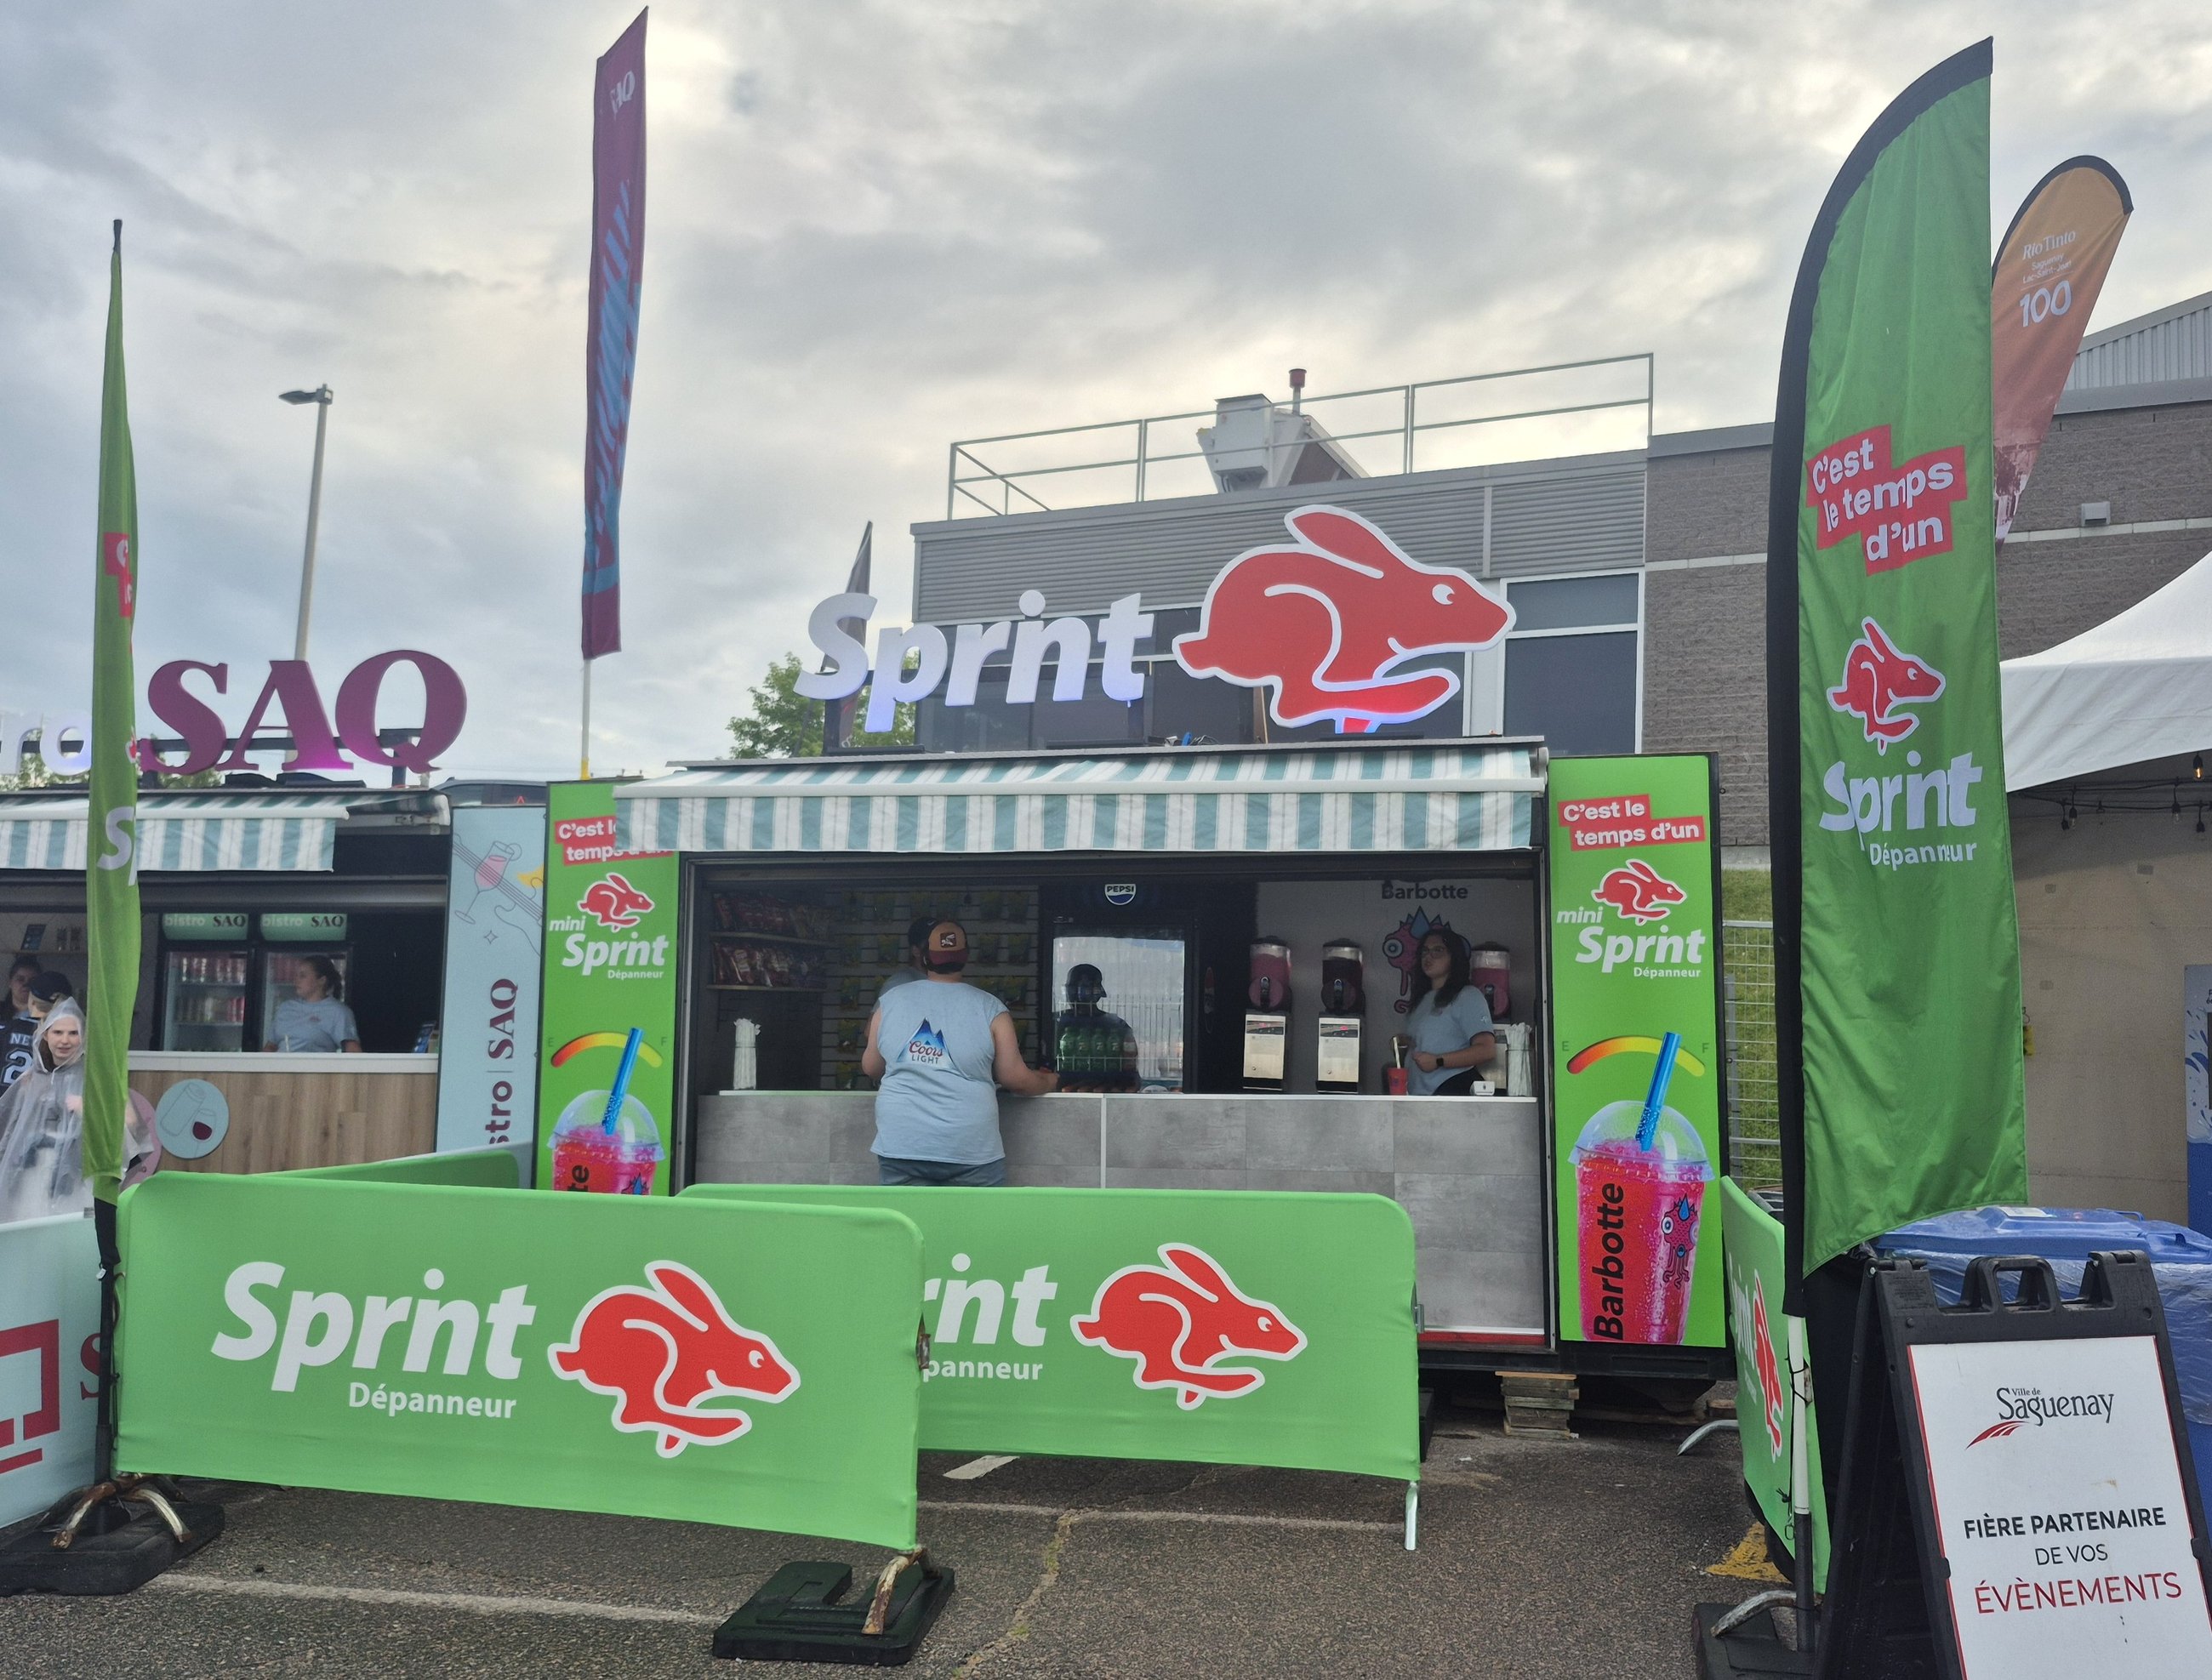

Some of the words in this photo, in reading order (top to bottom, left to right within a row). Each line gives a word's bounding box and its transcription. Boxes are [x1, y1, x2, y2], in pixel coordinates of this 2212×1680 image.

[2022, 243, 2043, 260] Rio
[2020, 281, 2072, 327] 100
[1811, 438, 1875, 495] C'est
[1823, 498, 1839, 532] le
[1843, 459, 1955, 516] temps
[1866, 516, 1944, 561] d'un
[794, 589, 1154, 732] Sprint
[140, 650, 467, 773] SAQ
[1563, 802, 1621, 822] C'est
[1625, 800, 1645, 817] le
[1819, 750, 1982, 851] Sprint
[559, 821, 604, 839] C'est
[1575, 829, 1646, 847] temps
[1650, 823, 1700, 840] d'un
[1382, 882, 1468, 900] Barbotte
[213, 915, 246, 927] SAQ
[311, 915, 344, 927] SAQ
[550, 915, 586, 931] mini
[1556, 906, 1604, 924] mini
[562, 931, 669, 976] Sprint
[1575, 925, 1706, 973] Sprint
[607, 970, 664, 981] Dépanneur
[1633, 966, 1701, 979] Dépanneur
[487, 978, 518, 1059] SAQ
[548, 1037, 554, 1047] E
[662, 1036, 668, 1046] F
[909, 1040, 944, 1057] Coors
[1562, 1041, 1570, 1051] E
[1702, 1043, 1709, 1053] F
[912, 1054, 939, 1064] LIGHT
[1592, 1183, 1626, 1341] Barbotte
[211, 1261, 537, 1392] Sprint
[923, 1360, 1043, 1382] panneur
[349, 1382, 516, 1419] Dépanneur
[2011, 1388, 2030, 1397] Ville
[1997, 1387, 2114, 1427] Saguenay
[1964, 1512, 2026, 1539] FIÈRE
[2030, 1506, 2166, 1534] PARTENAIRE
[2035, 1547, 2063, 1565] DE
[2066, 1543, 2108, 1563] VOS
[1975, 1572, 2182, 1614] ÉVÈNEMENTS
